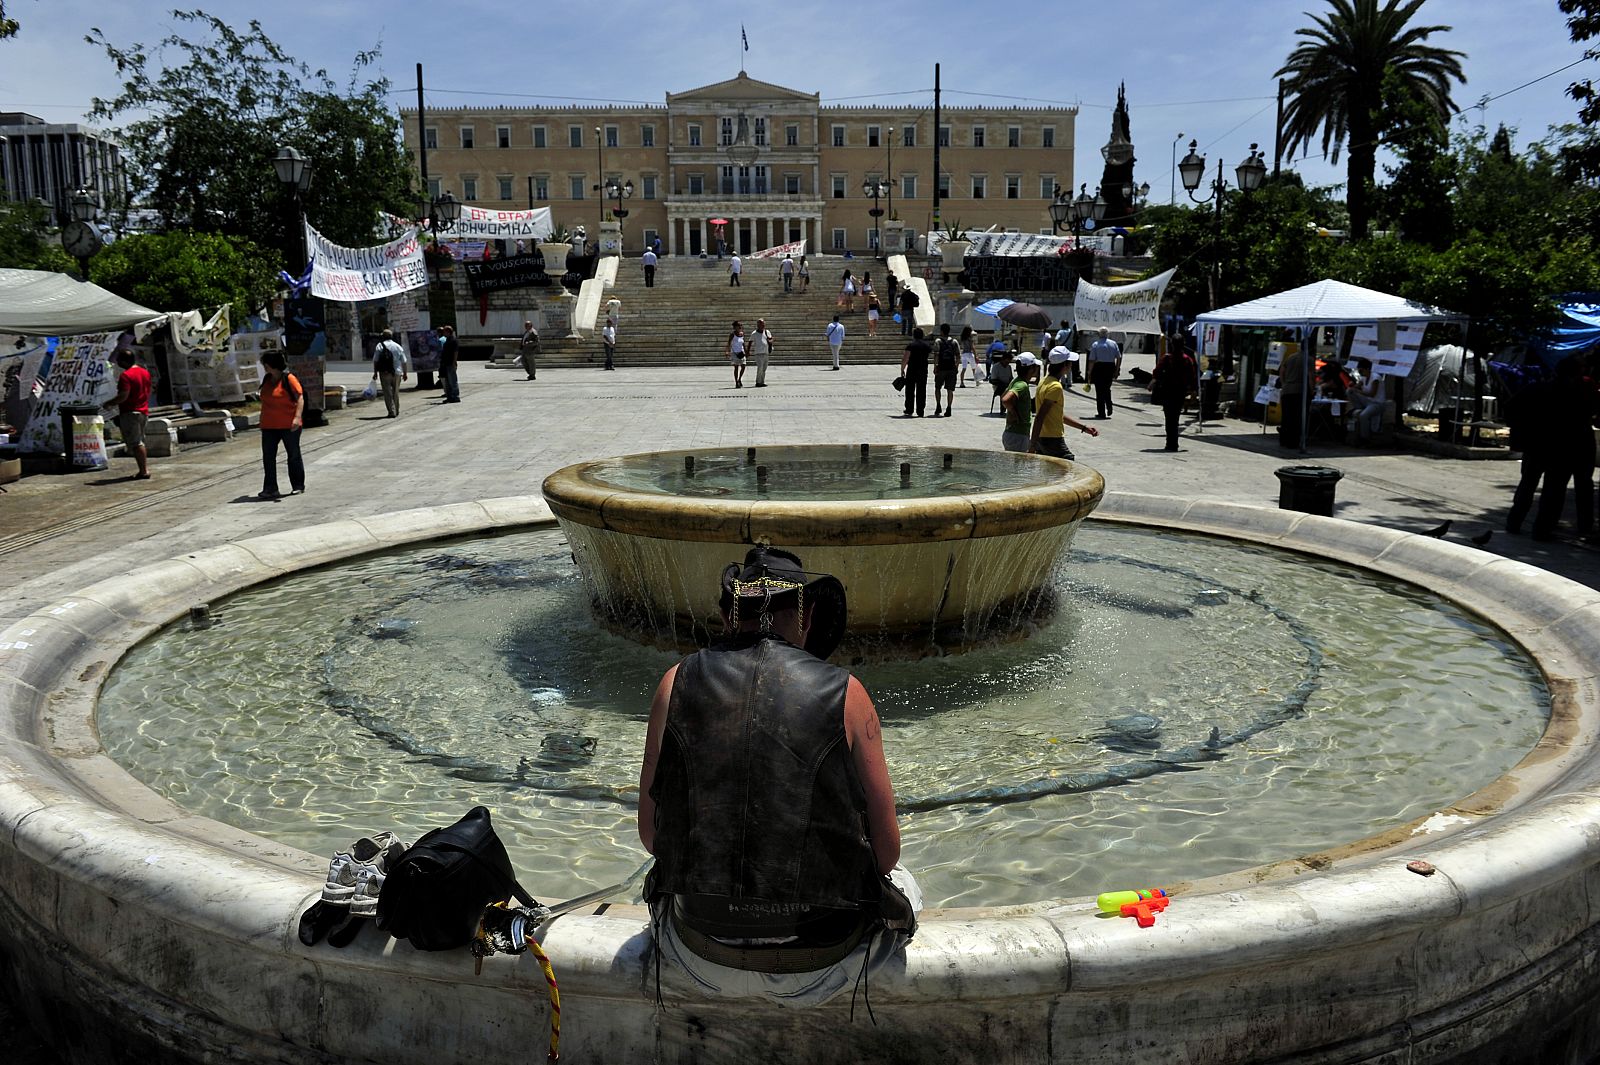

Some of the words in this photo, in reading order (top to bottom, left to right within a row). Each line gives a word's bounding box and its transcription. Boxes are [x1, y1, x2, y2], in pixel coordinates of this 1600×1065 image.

[468, 264, 482, 275] ET
[514, 257, 545, 267] COMBIE
[1004, 268, 1026, 278] THE
[475, 279, 497, 289] TEMPS
[969, 277, 1076, 291] REVOLUTION
